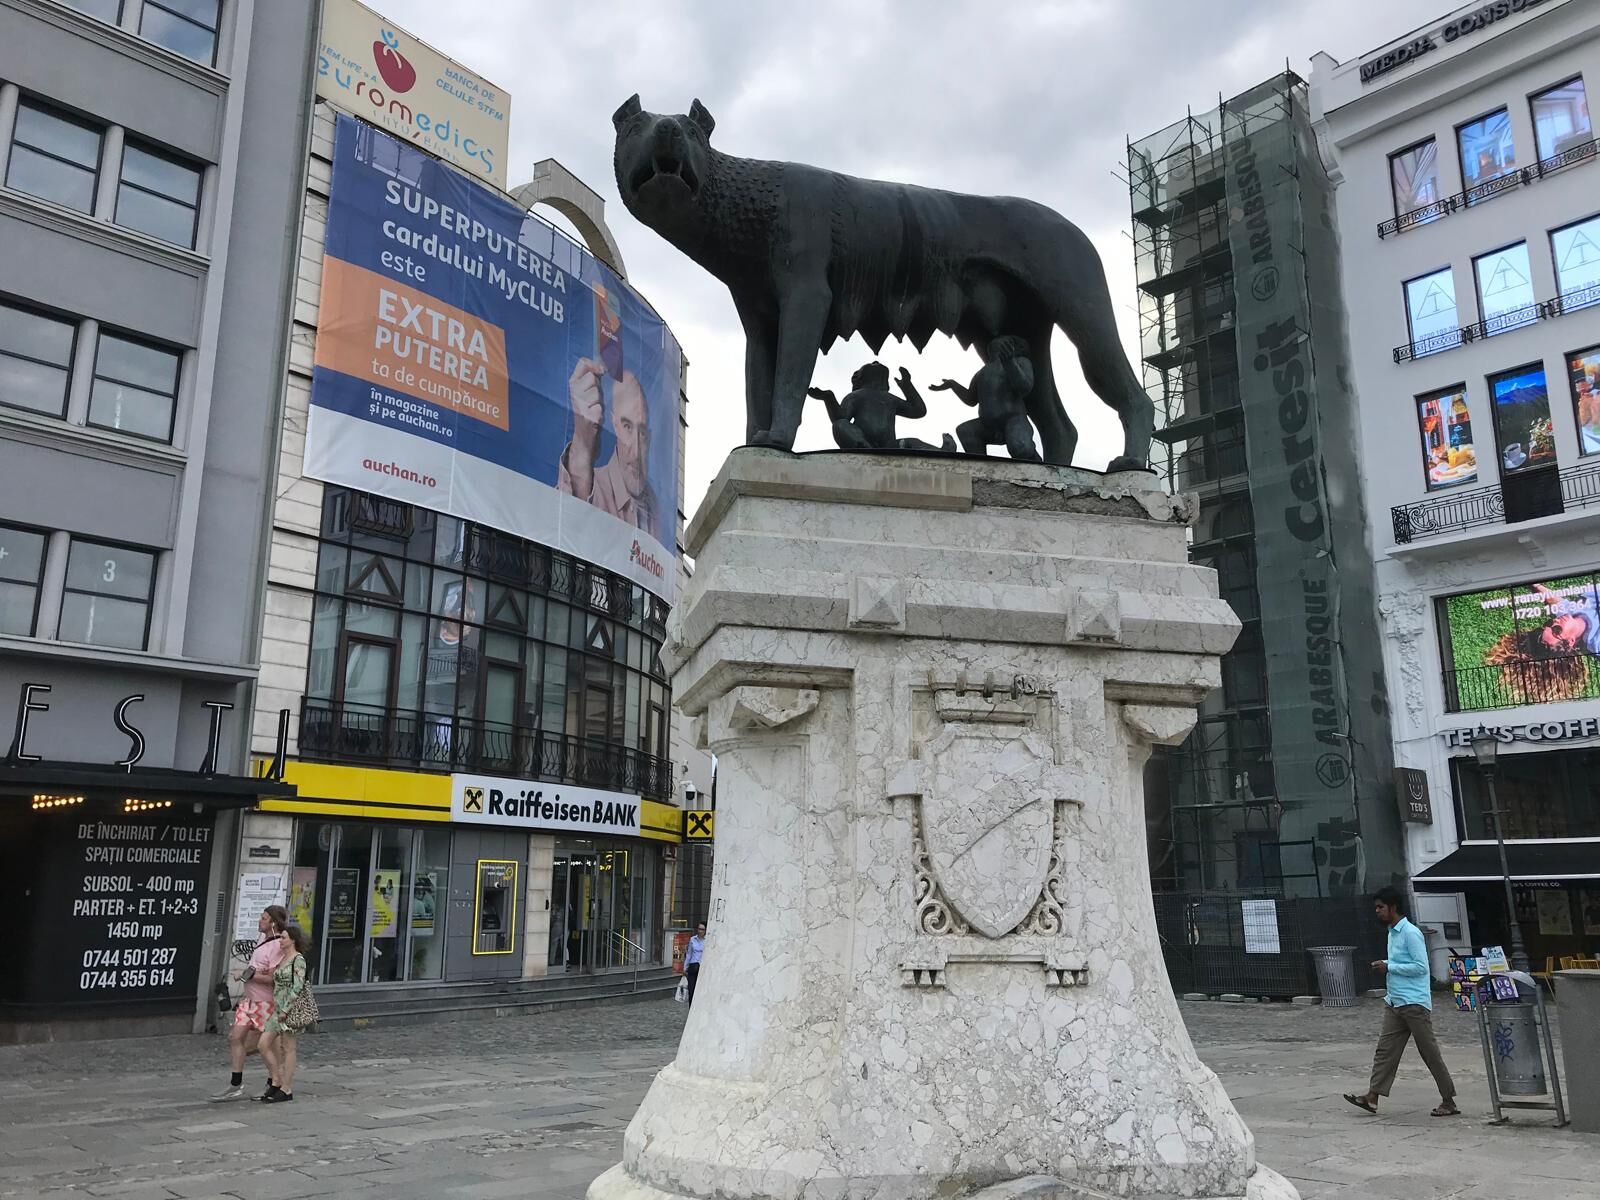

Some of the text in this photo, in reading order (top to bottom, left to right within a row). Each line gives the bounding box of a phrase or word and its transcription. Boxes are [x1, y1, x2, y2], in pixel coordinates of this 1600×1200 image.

[1360, 0, 1545, 81] MEDIA CONSU
[436, 78, 475, 105] CELULE
[482, 89, 496, 103] DE
[318, 55, 493, 173] euromedics
[385, 179, 566, 294] SUPERPUTEREA
[381, 250, 426, 282] este
[383, 219, 564, 324] cardului MyCLUB
[378, 288, 489, 363] EXTRA
[375, 325, 489, 391] PUTEREA
[370, 387, 439, 420] în magazine
[372, 358, 500, 419] ta de cumpărare
[369, 401, 453, 438] și pe auchan.ro
[1253, 315, 1325, 542] Ceresit
[362, 456, 437, 488] auchan.ro
[103, 560, 116, 582] 3
[630, 539, 664, 579] Auchan
[1544, 603, 1566, 615] 103
[1570, 600, 1591, 612] 364
[1303, 579, 1341, 747] ARABESQUE
[488, 789, 637, 827] Raiffeisen BANK
[78, 824, 94, 839] DE
[97, 821, 157, 841] ÎNCHIRIAT
[172, 827, 186, 842] TO
[189, 827, 210, 842] LET
[85, 847, 201, 866] SPAȚII COMERCIALE
[83, 876, 134, 893] SUBSOL
[146, 876, 171, 892] 400
[174, 879, 194, 894] mp
[73, 898, 198, 916] PARTER + ET. 1+2+3
[107, 922, 163, 940] 1450 mp
[83, 948, 177, 968] 0744 501 287
[80, 969, 174, 989] 0744 355 614
